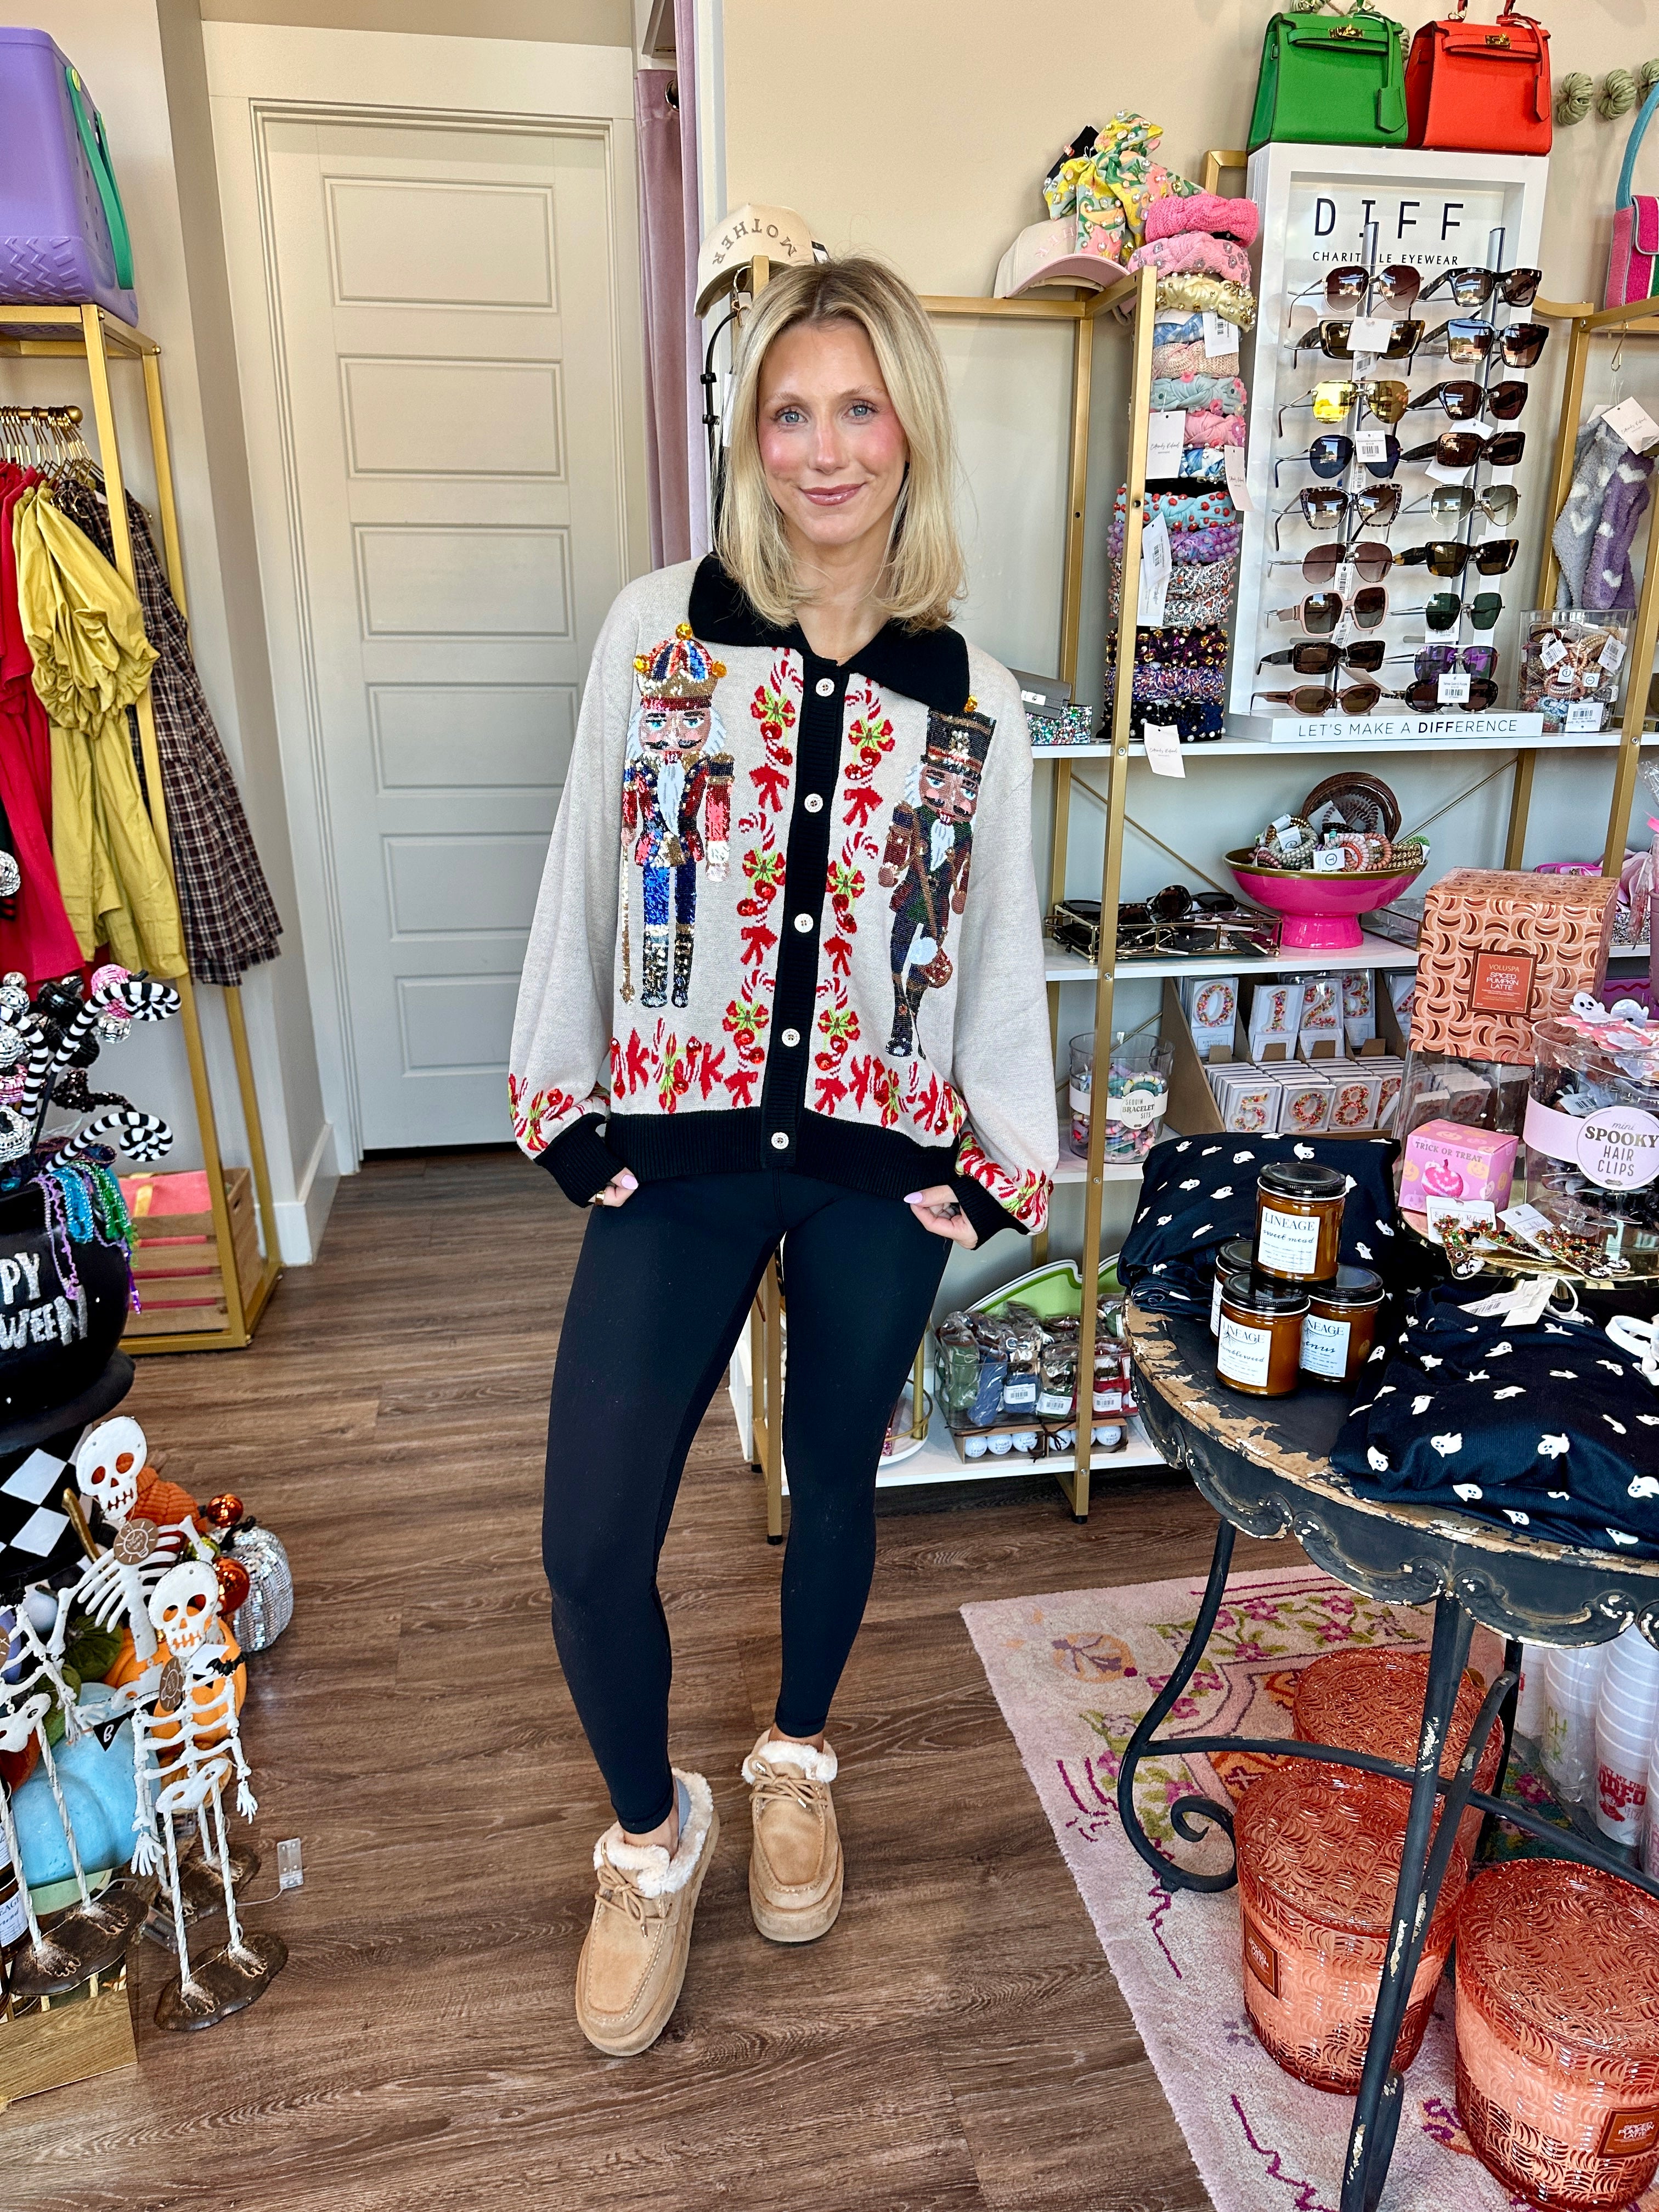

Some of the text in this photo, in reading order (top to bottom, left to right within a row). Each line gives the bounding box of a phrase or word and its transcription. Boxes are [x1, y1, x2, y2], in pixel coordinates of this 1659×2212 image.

[1314, 198, 1464, 241] DIFF
[712, 218, 798, 266] MOTHER
[1312, 251, 1459, 266] CHARITLE EYEWEAR
[1298, 719, 1518, 737] LET'S MAKE A DIFFERENCE
[1488, 963, 1520, 973] VOLUSPA
[1489, 971, 1517, 980] SPICED
[1486, 977, 1519, 986] PUMPKIN
[1490, 983, 1514, 991] LATTE
[1122, 1104, 1155, 1114] BRACELET
[1611, 1122, 1635, 1130] mini
[1584, 1126, 1659, 1148] SPOOKY
[1415, 1141, 1482, 1163] TRICK OR TREAT
[1603, 1145, 1634, 1161] HAIR
[1597, 1159, 1635, 1177] CLIPS
[1264, 1211, 1316, 1232] LINEAGE
[1262, 1229, 1286, 1240] sweet
[1222, 1321, 1266, 1344] LINEAGE
[1307, 1318, 1345, 1336] NEAGE
